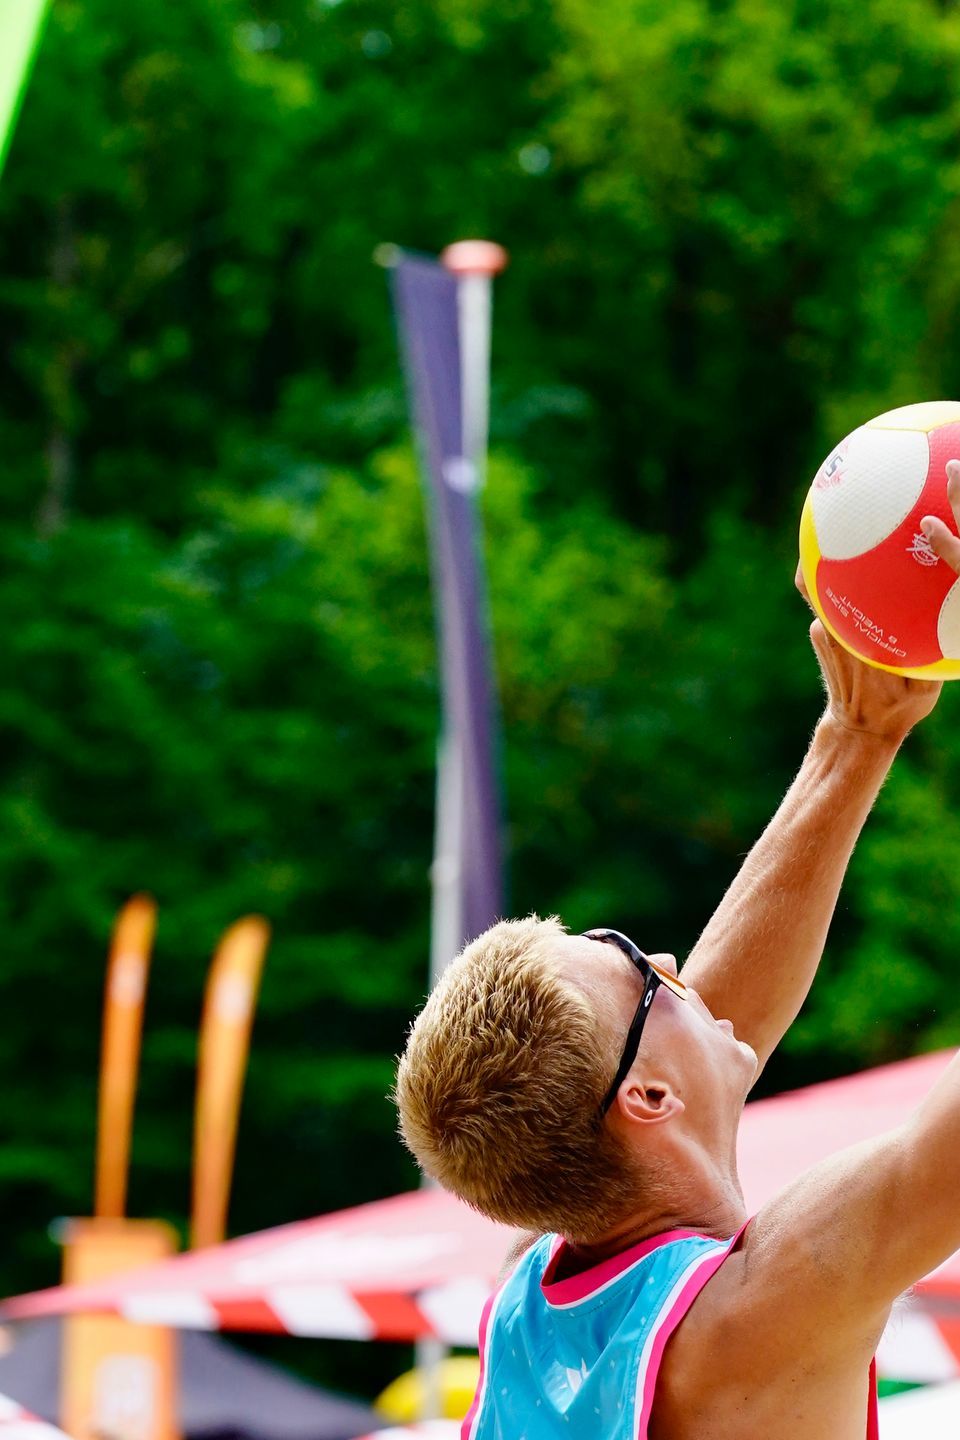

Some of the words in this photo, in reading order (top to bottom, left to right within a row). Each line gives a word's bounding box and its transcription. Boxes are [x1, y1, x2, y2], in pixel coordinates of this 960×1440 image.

[825, 587, 850, 618] SIZE
[839, 595, 885, 636] WEIGHT
[852, 617, 908, 658] OFFICIAL
